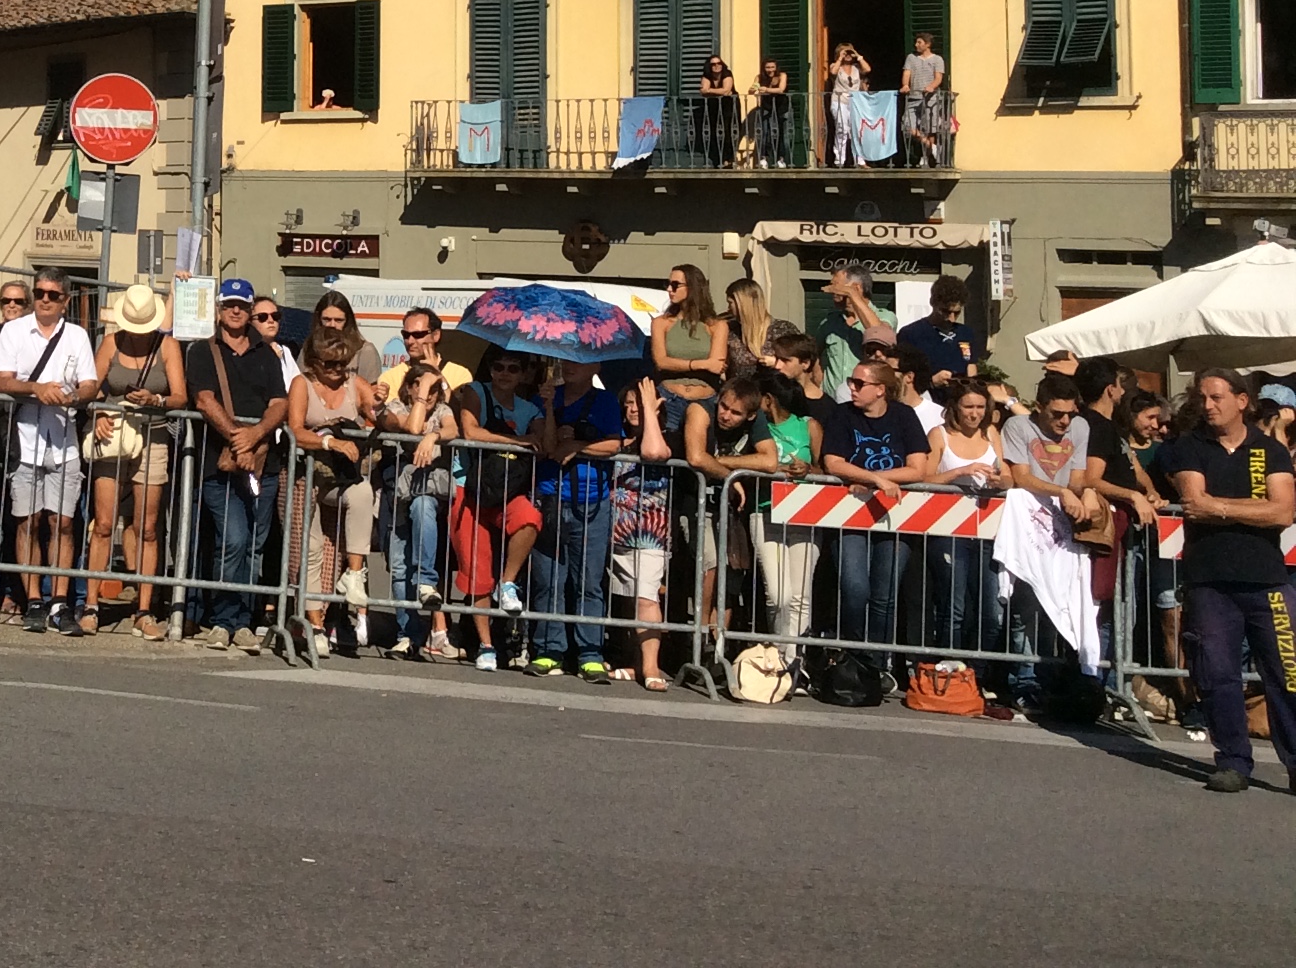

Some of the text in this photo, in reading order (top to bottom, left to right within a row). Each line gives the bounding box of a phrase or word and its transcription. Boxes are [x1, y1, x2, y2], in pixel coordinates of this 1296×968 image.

[35, 227, 94, 242] FERRAMENTA
[799, 223, 938, 239] RIC. LOTTO
[292, 238, 370, 254] EDICOLA
[383, 294, 424, 309] MOBILE
[425, 295, 437, 309] DI
